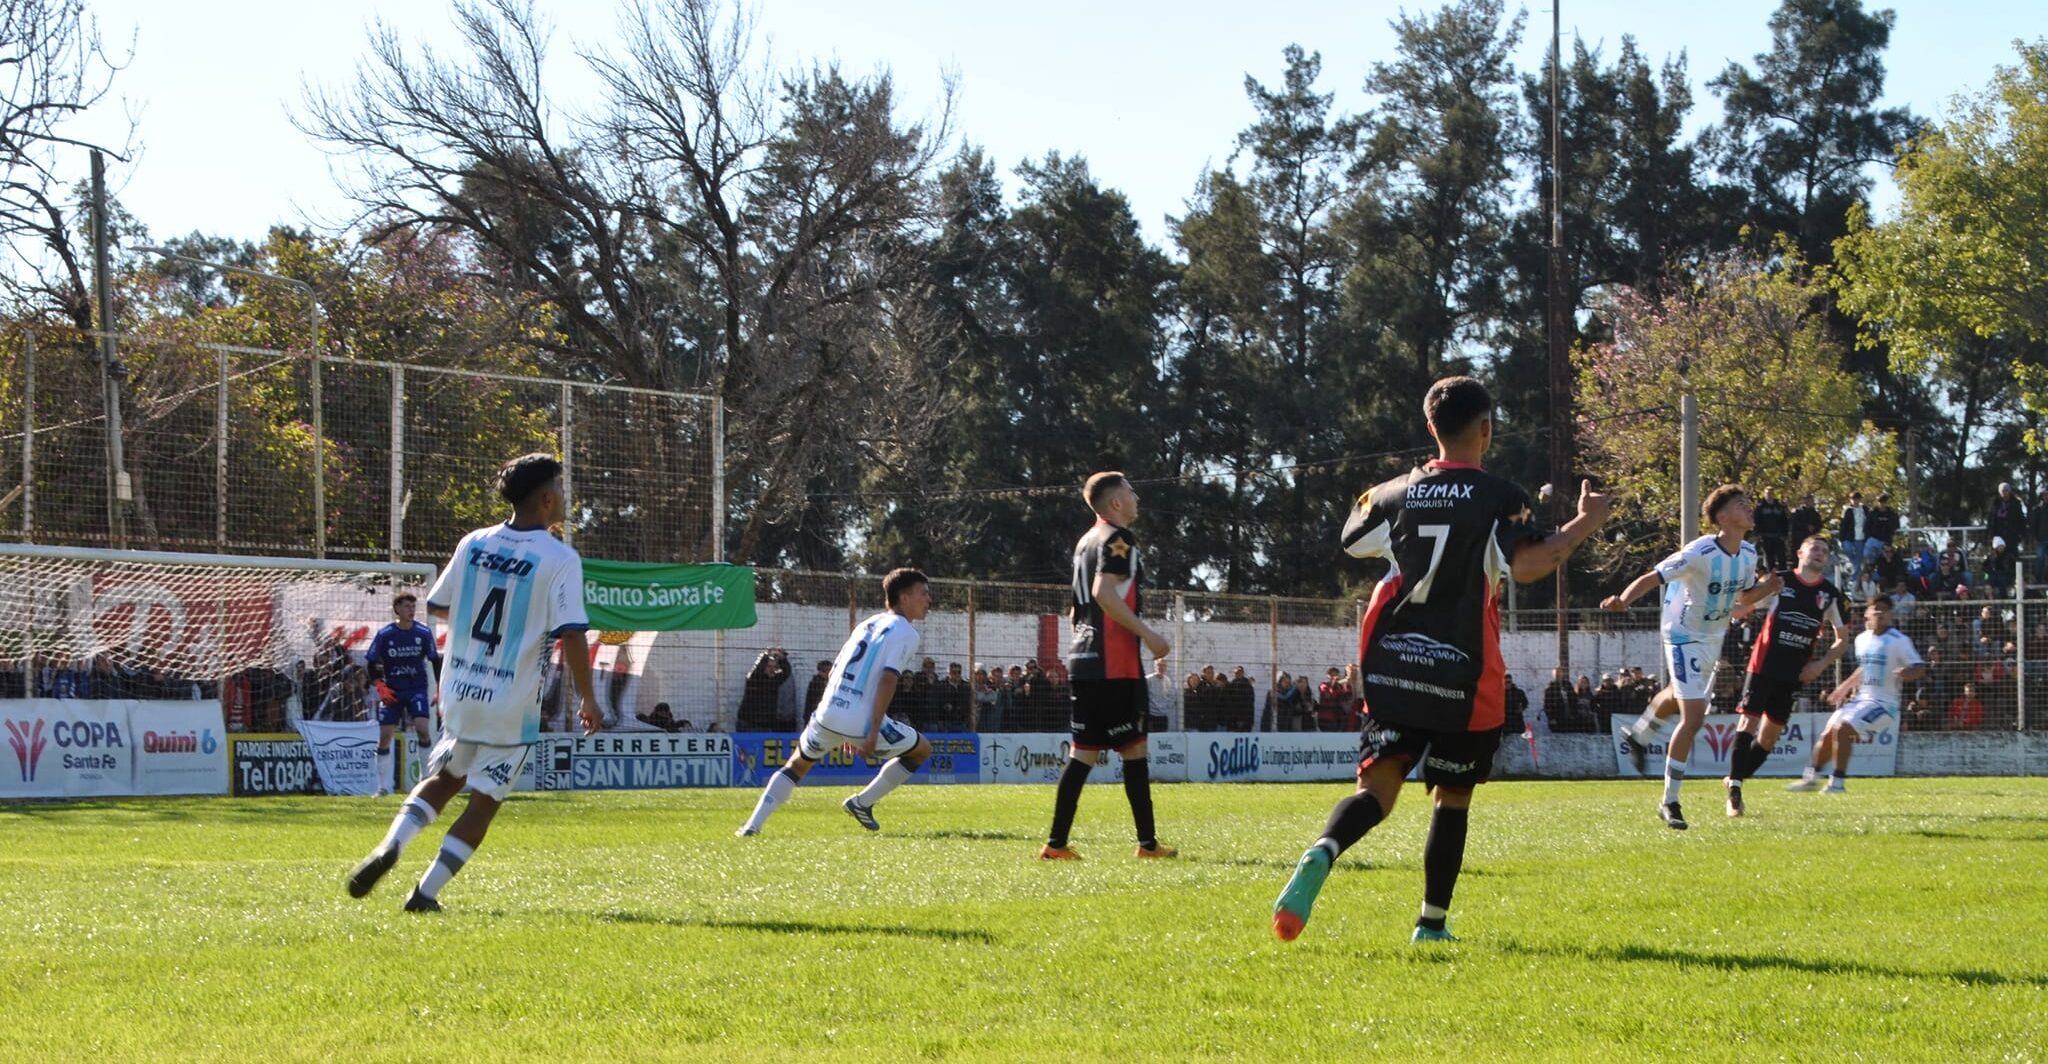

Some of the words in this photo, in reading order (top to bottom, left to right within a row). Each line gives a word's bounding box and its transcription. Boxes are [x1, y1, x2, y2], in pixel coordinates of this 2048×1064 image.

[1406, 484, 1474, 499] RE/MAX
[1410, 524, 1450, 605] 7
[584, 580, 644, 606] Banco
[646, 581, 701, 607] Santa
[703, 582, 724, 604] Fe
[471, 586, 508, 657] 4
[842, 640, 869, 682] 2
[53, 721, 124, 748] COPA
[143, 730, 197, 753] Quini
[201, 728, 217, 754] 6
[576, 739, 732, 753] FERRETERA
[1878, 727, 1893, 745] 6
[63, 754, 100, 769] Santa
[102, 754, 117, 769] Fe
[272, 741, 313, 758] INDUSTR
[544, 772, 571, 790] SM
[574, 758, 626, 788] SAN
[632, 757, 729, 787] MARTIN
